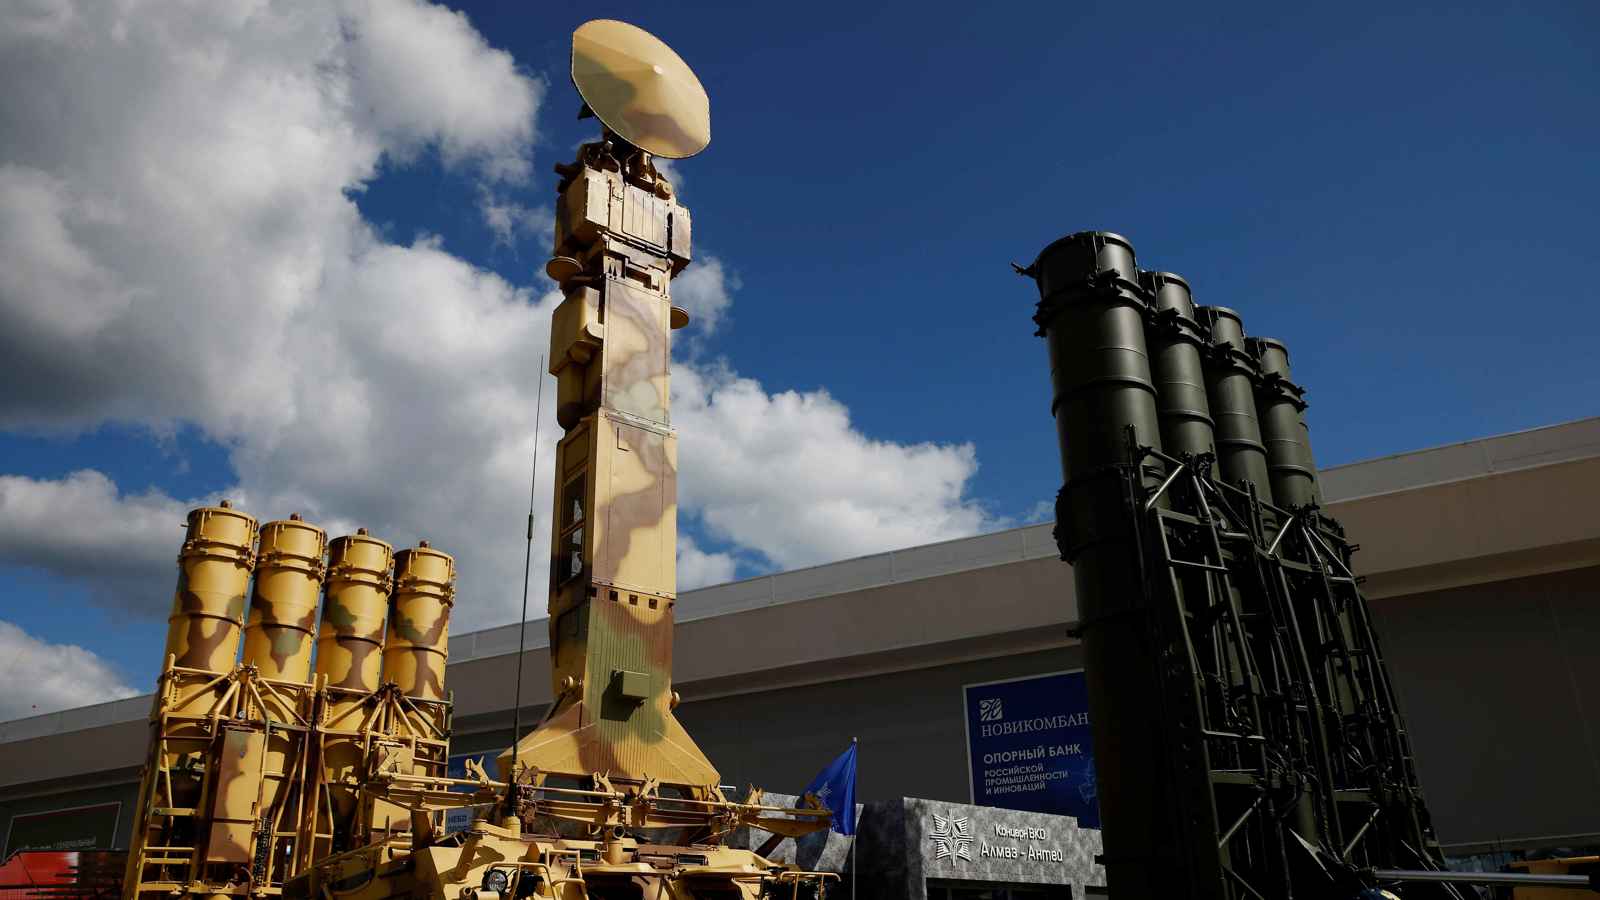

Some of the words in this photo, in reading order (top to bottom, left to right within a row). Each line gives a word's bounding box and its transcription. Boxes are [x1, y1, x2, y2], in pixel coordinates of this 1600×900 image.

[982, 712, 1089, 737] НОВИКОМБАН
[984, 745, 1046, 764] ОПОРНЫЙ
[1049, 743, 1082, 757] БАНК
[985, 763, 1044, 777] РОССИЙСКОЙ
[985, 771, 1069, 786] ПРОМЫШЛЕННОСТИ
[994, 782, 1046, 794] ИННОВАЦИЙ
